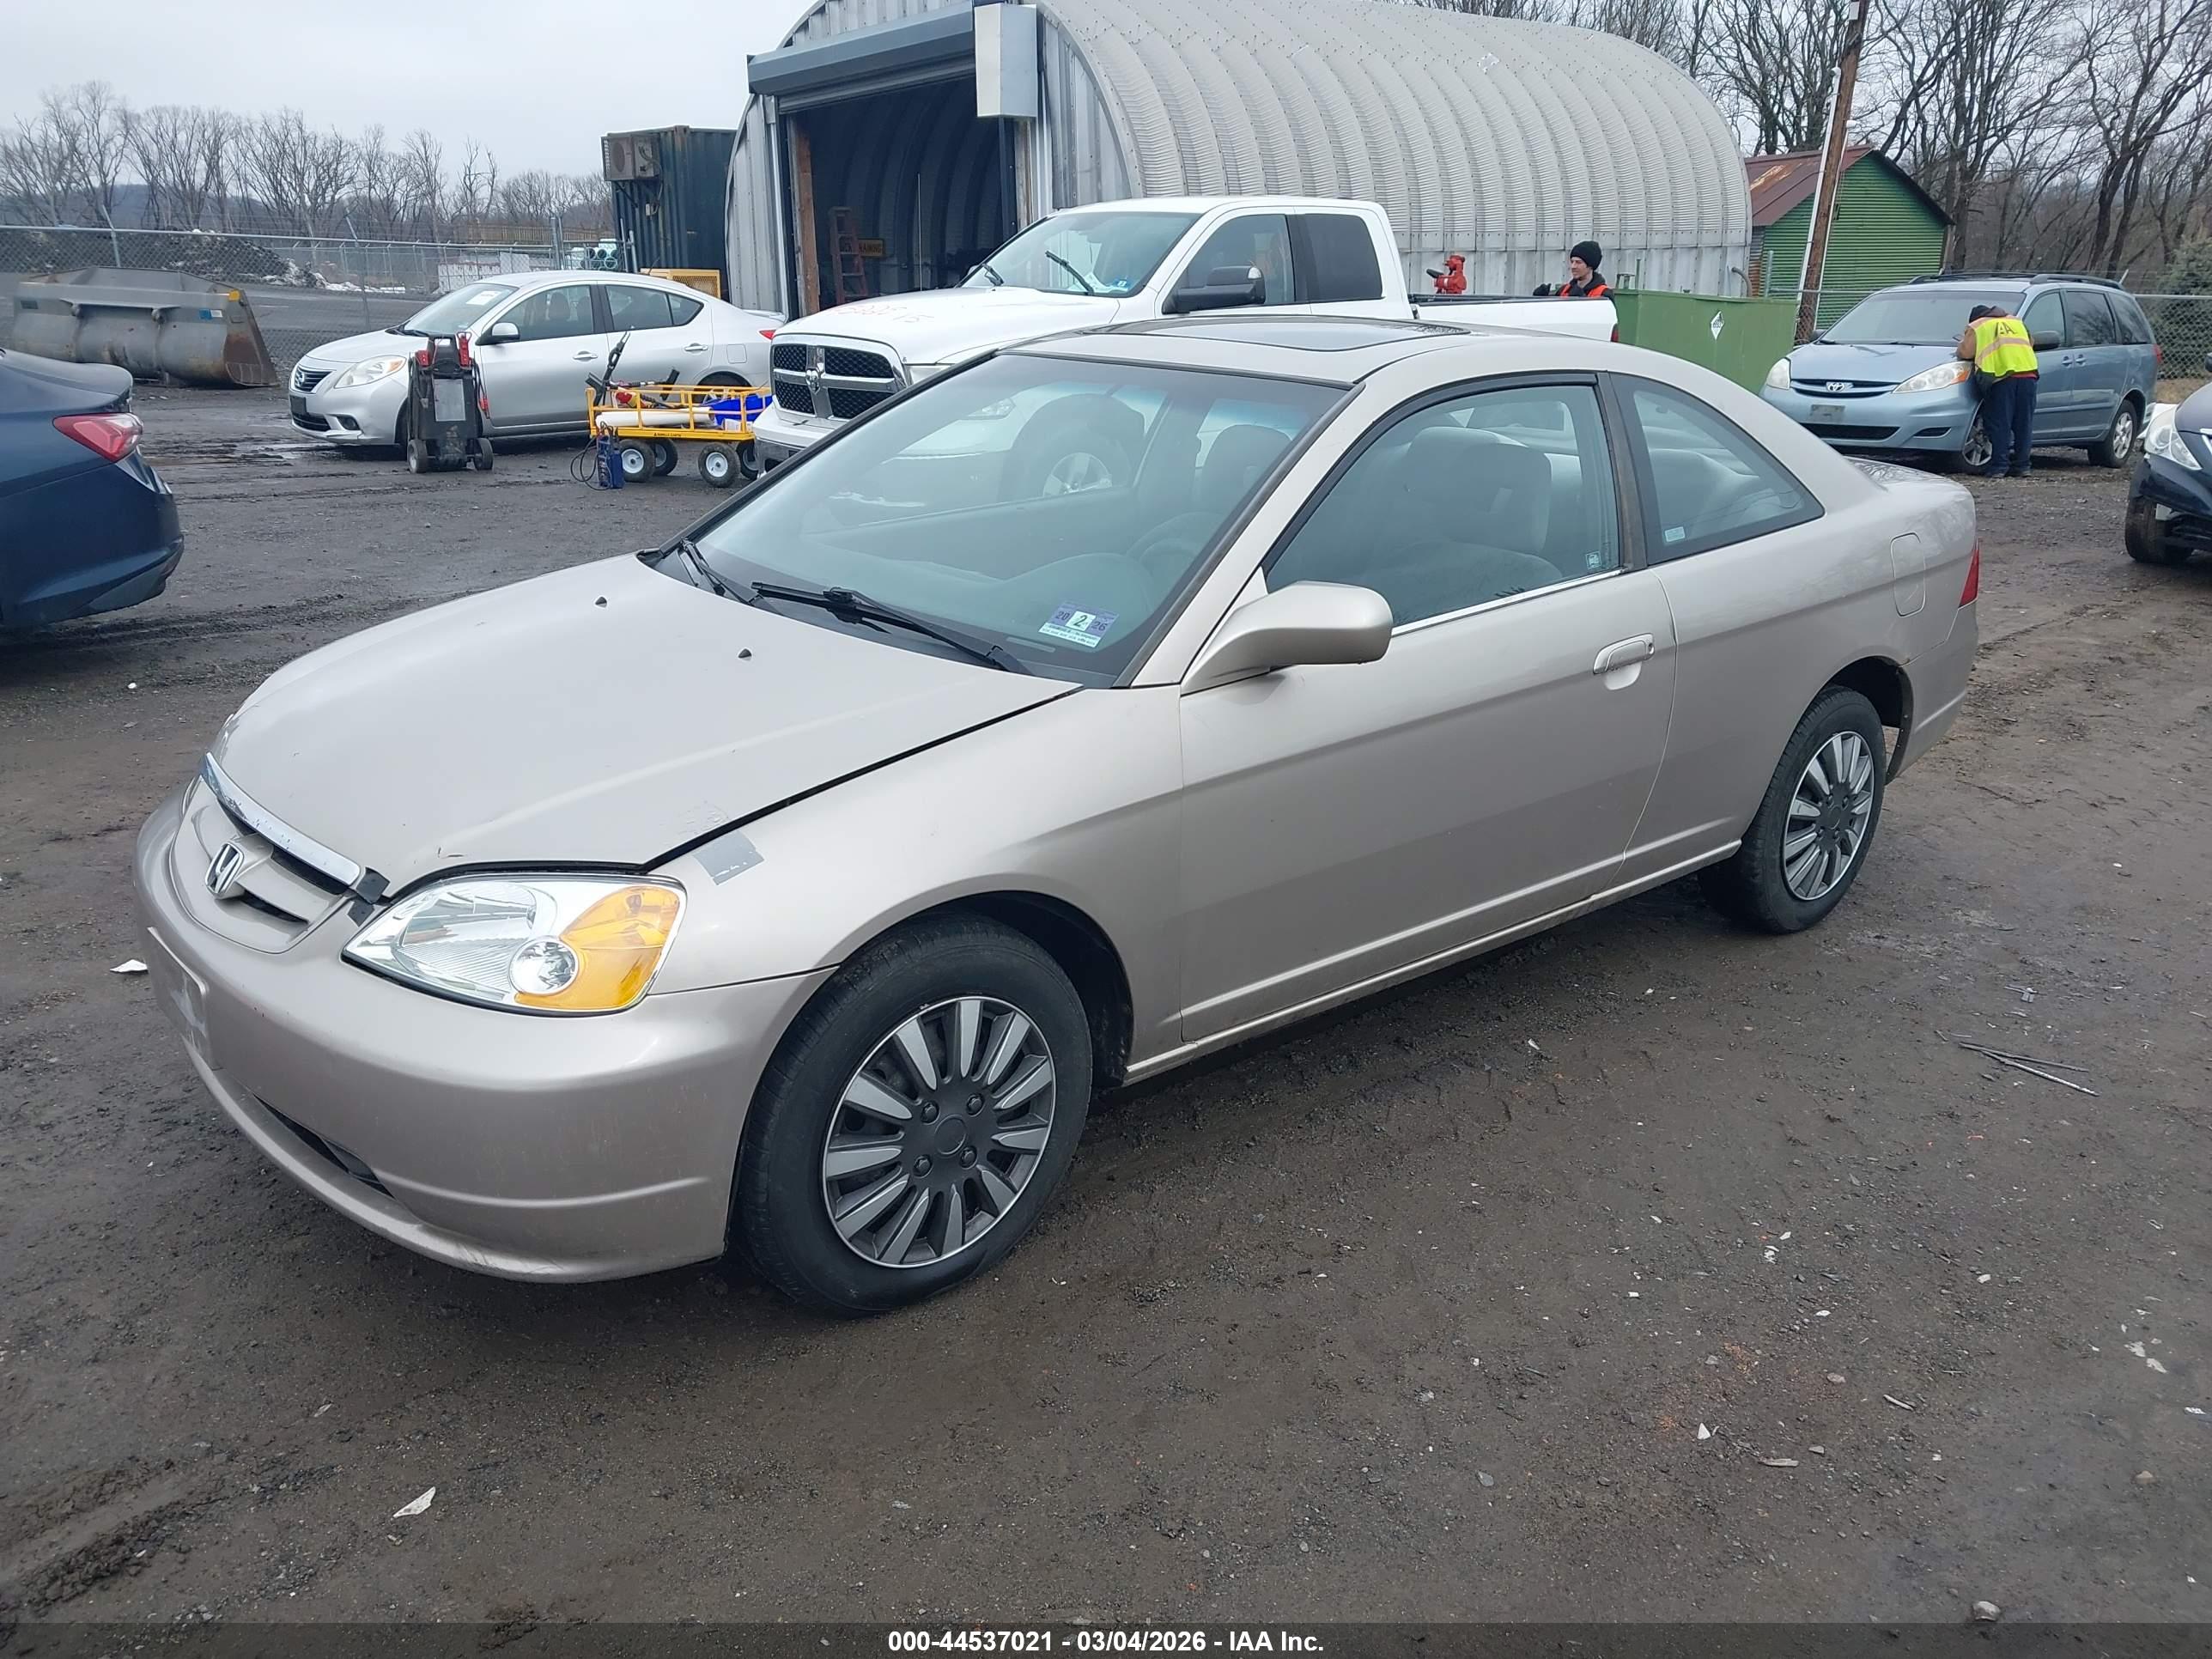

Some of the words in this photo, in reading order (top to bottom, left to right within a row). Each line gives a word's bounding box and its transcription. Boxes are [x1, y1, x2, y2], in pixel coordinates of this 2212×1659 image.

[1055, 611, 1071, 621] 20
[1073, 614, 1089, 628] 2
[1091, 621, 1109, 631] 26
